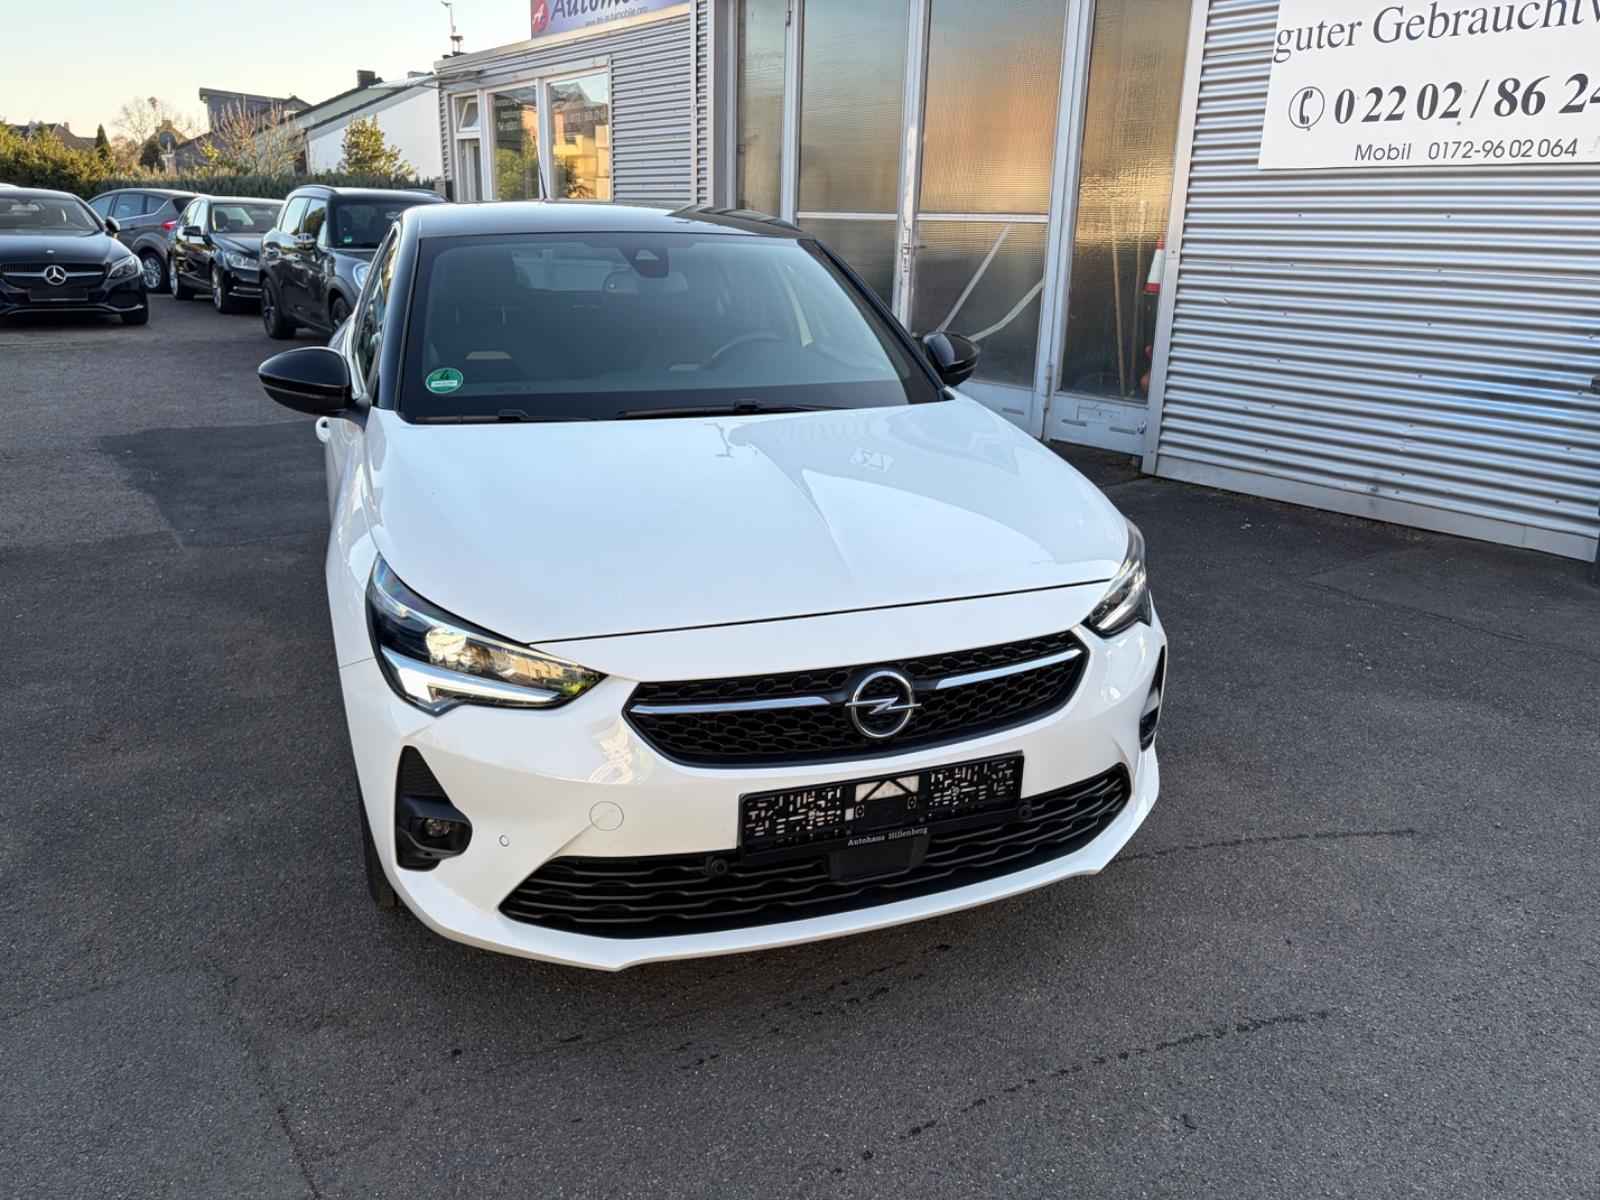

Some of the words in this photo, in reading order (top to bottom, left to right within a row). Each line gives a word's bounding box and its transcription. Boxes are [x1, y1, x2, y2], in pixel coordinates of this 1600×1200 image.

[1273, 20, 1363, 64] guter
[1373, 0, 1600, 44] Gebraucht
[1354, 142, 1412, 161] Mobil
[848, 835, 885, 846] Autohaus
